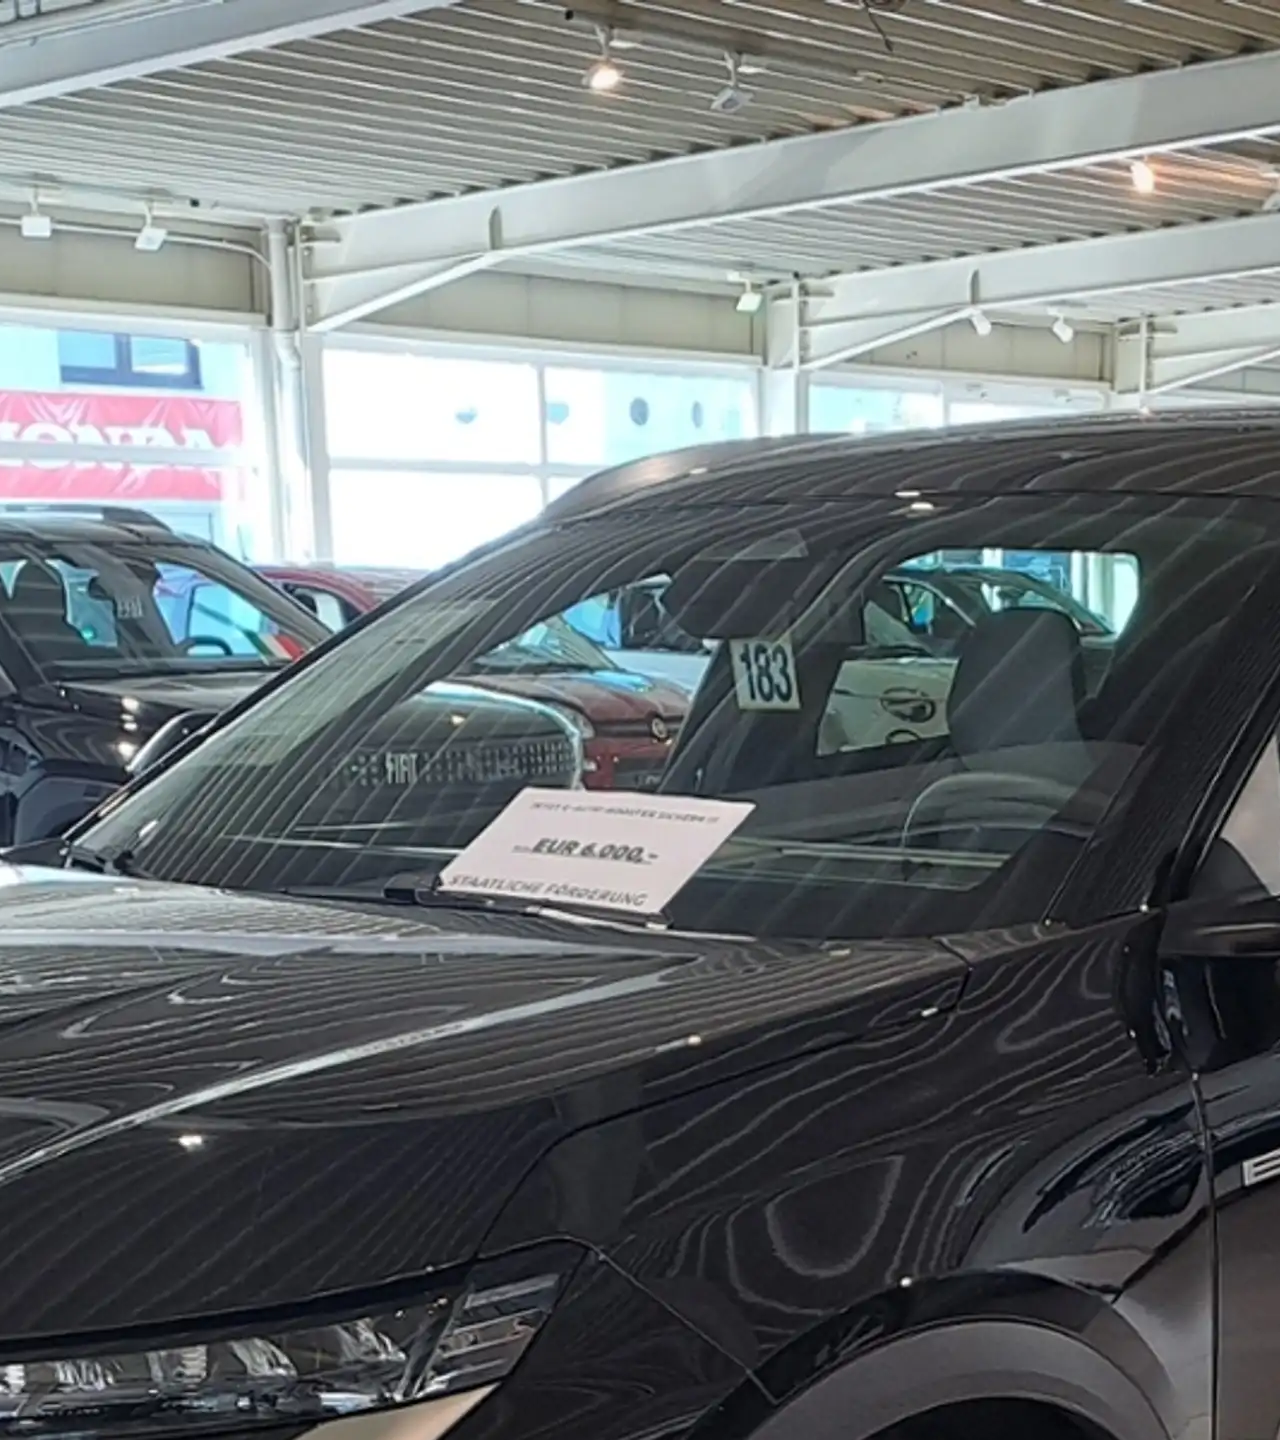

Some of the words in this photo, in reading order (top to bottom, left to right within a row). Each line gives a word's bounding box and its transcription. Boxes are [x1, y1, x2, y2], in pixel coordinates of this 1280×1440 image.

[740, 642, 792, 702] 183
[385, 752, 419, 784] FIAT
[531, 837, 580, 856] EUR
[447, 873, 544, 896] STAATLICHE
[545, 880, 649, 907] FÖRDERUNG
